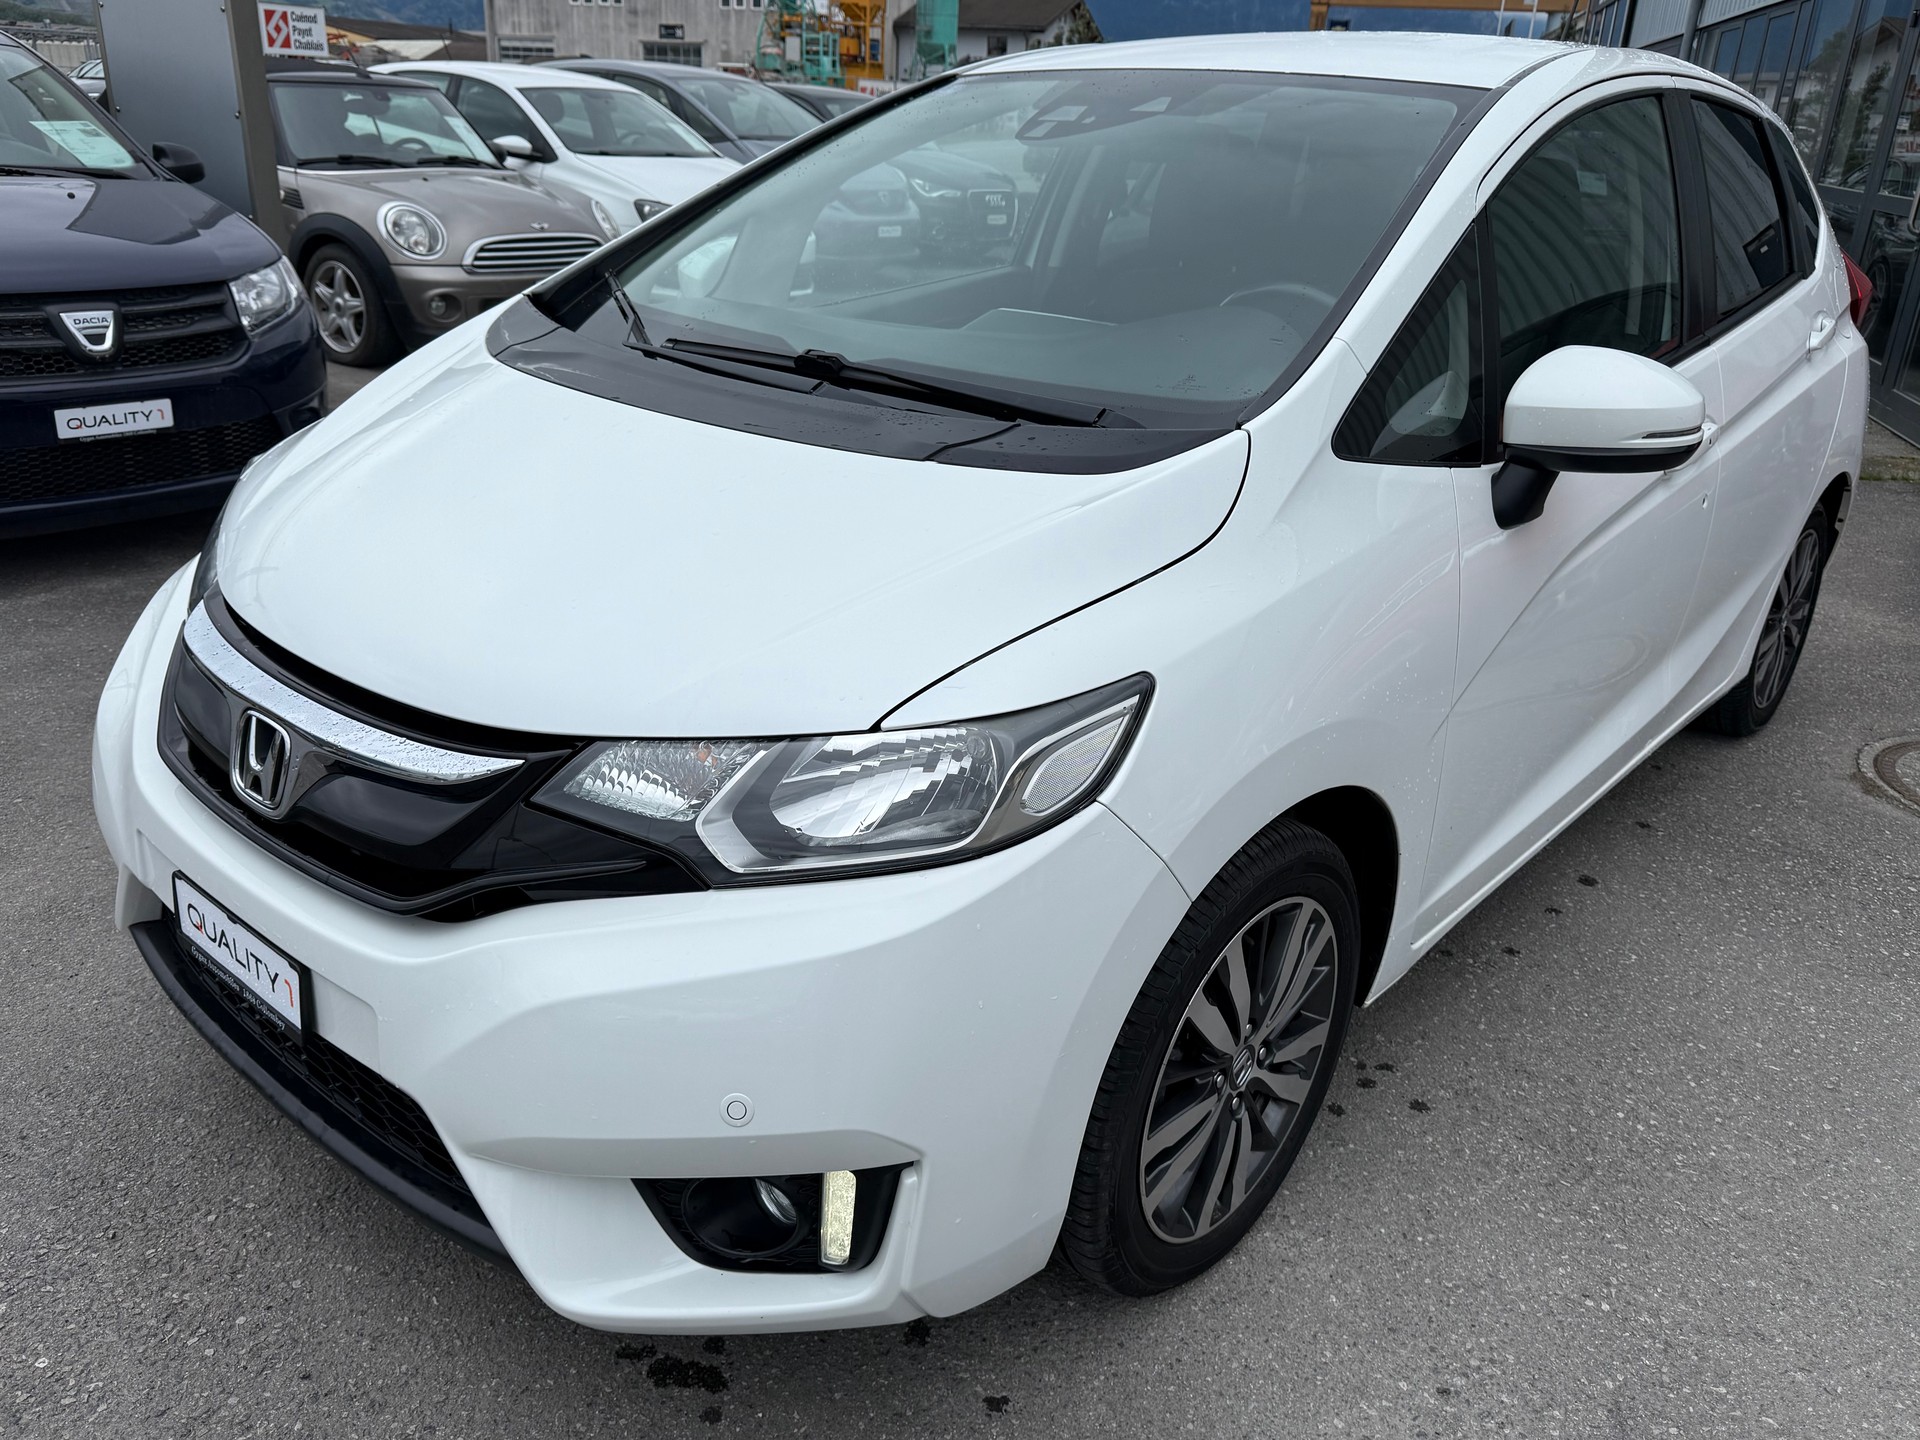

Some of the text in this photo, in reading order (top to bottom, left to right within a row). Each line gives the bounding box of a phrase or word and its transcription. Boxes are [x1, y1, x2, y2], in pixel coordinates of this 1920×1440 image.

[292, 25, 313, 39] Payot
[294, 39, 324, 51] Chablais
[73, 317, 109, 325] DACIA
[66, 410, 153, 430] QUALITY
[187, 903, 279, 993] QUALITY
